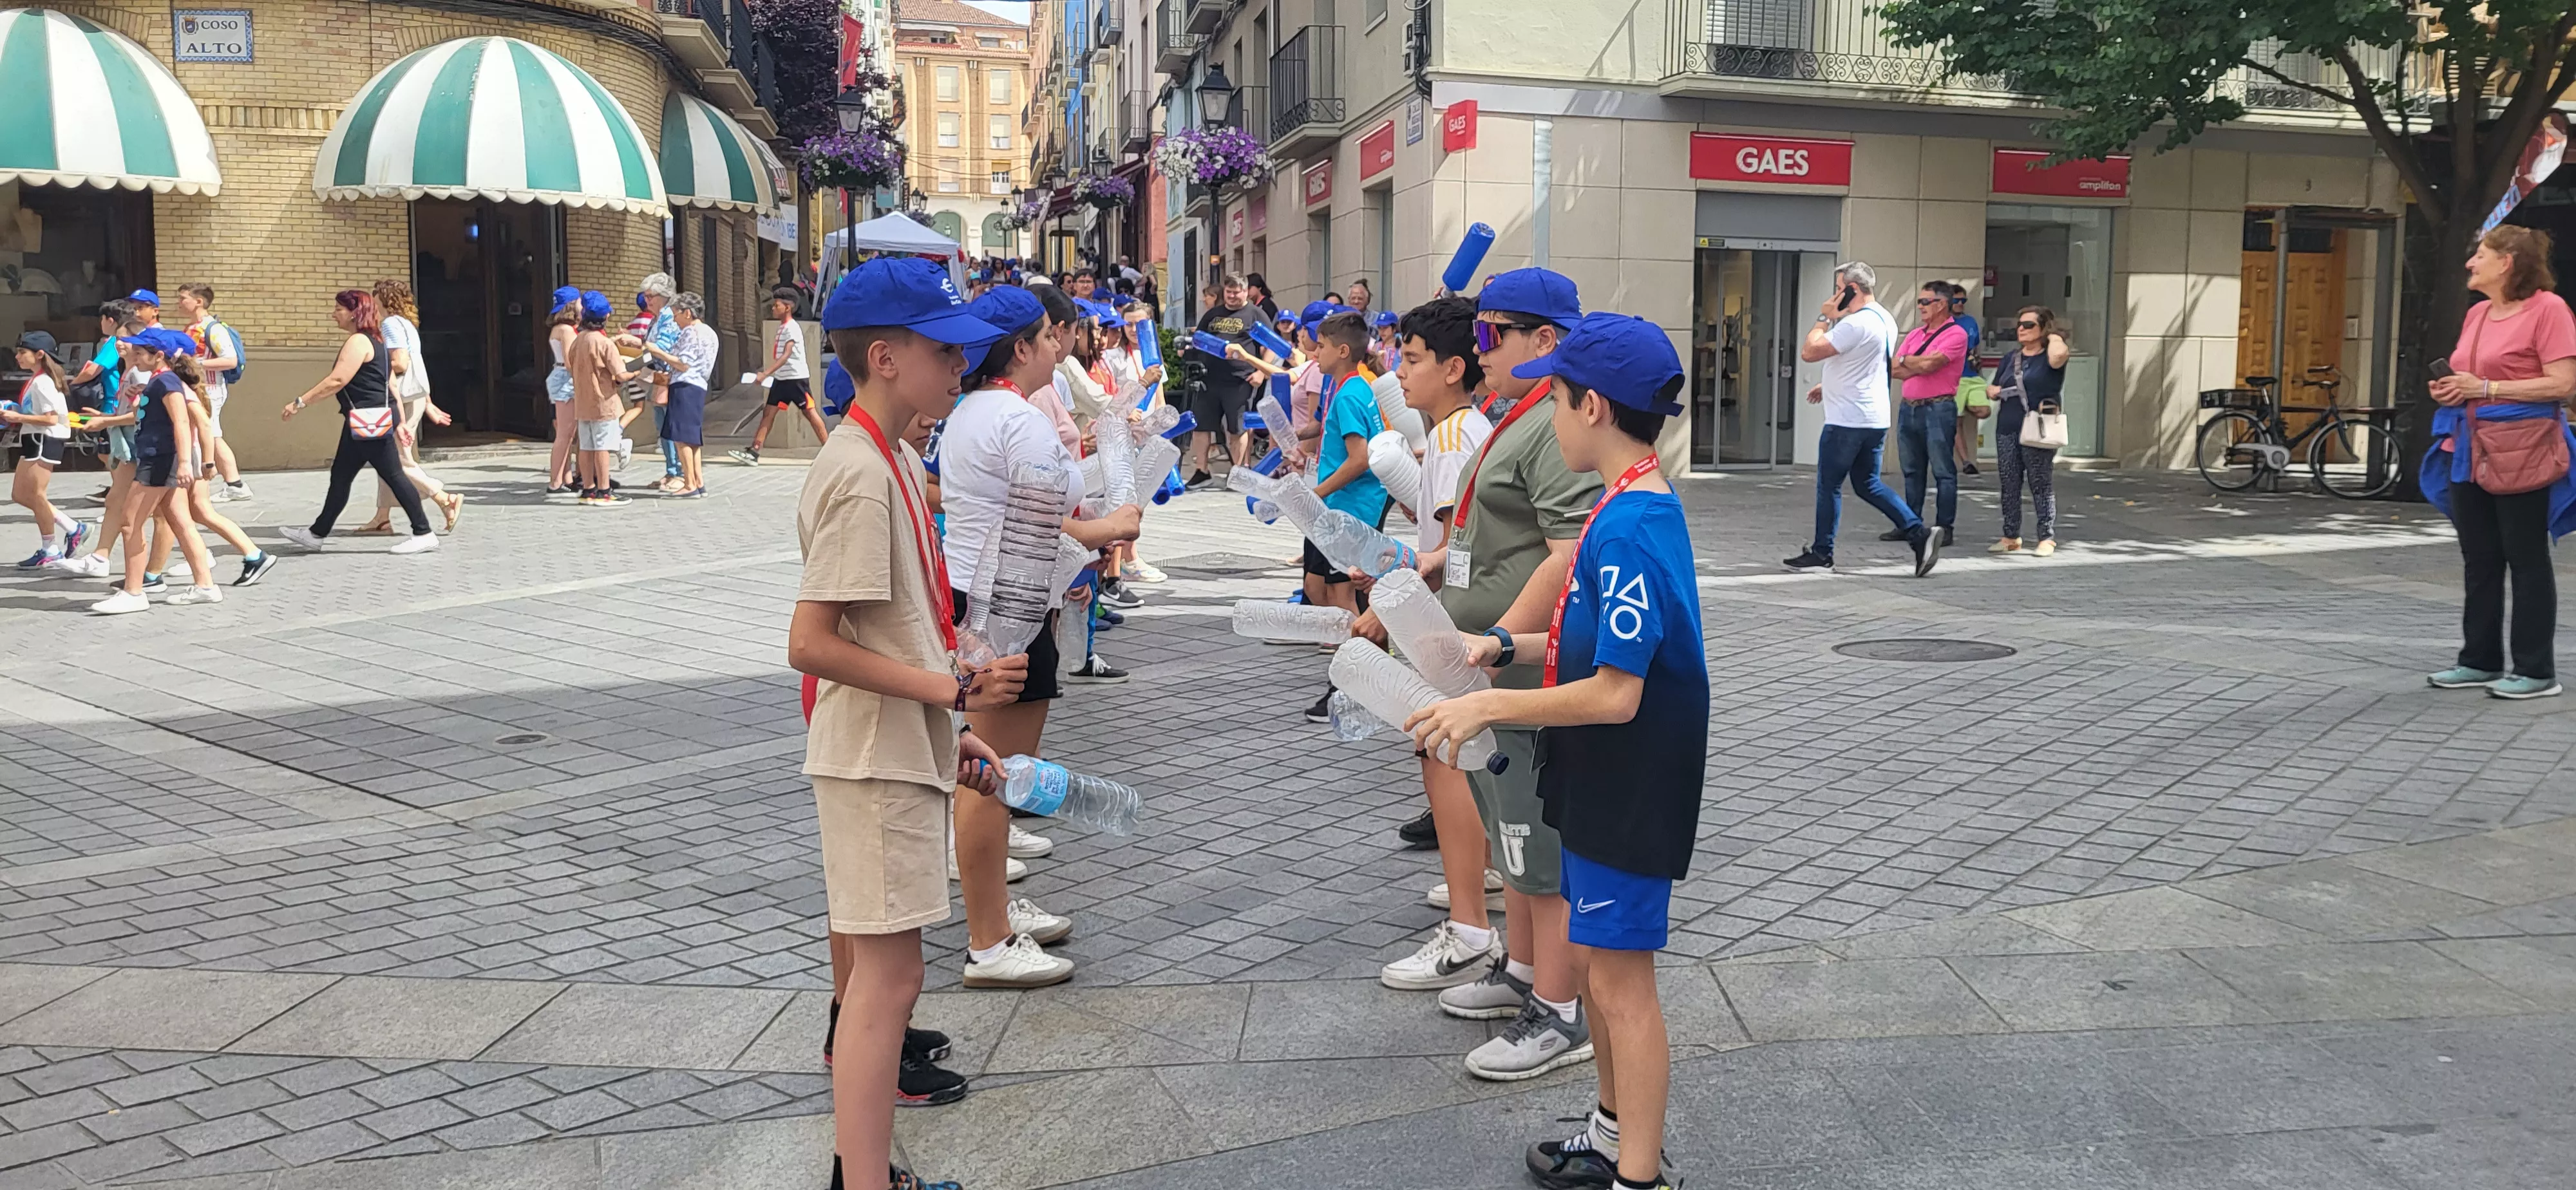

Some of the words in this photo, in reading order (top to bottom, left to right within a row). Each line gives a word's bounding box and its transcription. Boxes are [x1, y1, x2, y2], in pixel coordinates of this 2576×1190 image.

[201, 20, 238, 30] COSO
[185, 42, 242, 54] ALTO
[1448, 115, 1466, 133] GAES
[1736, 147, 1809, 176] GAES
[2079, 180, 2121, 192] amplifon
[1501, 831, 1525, 876] U
